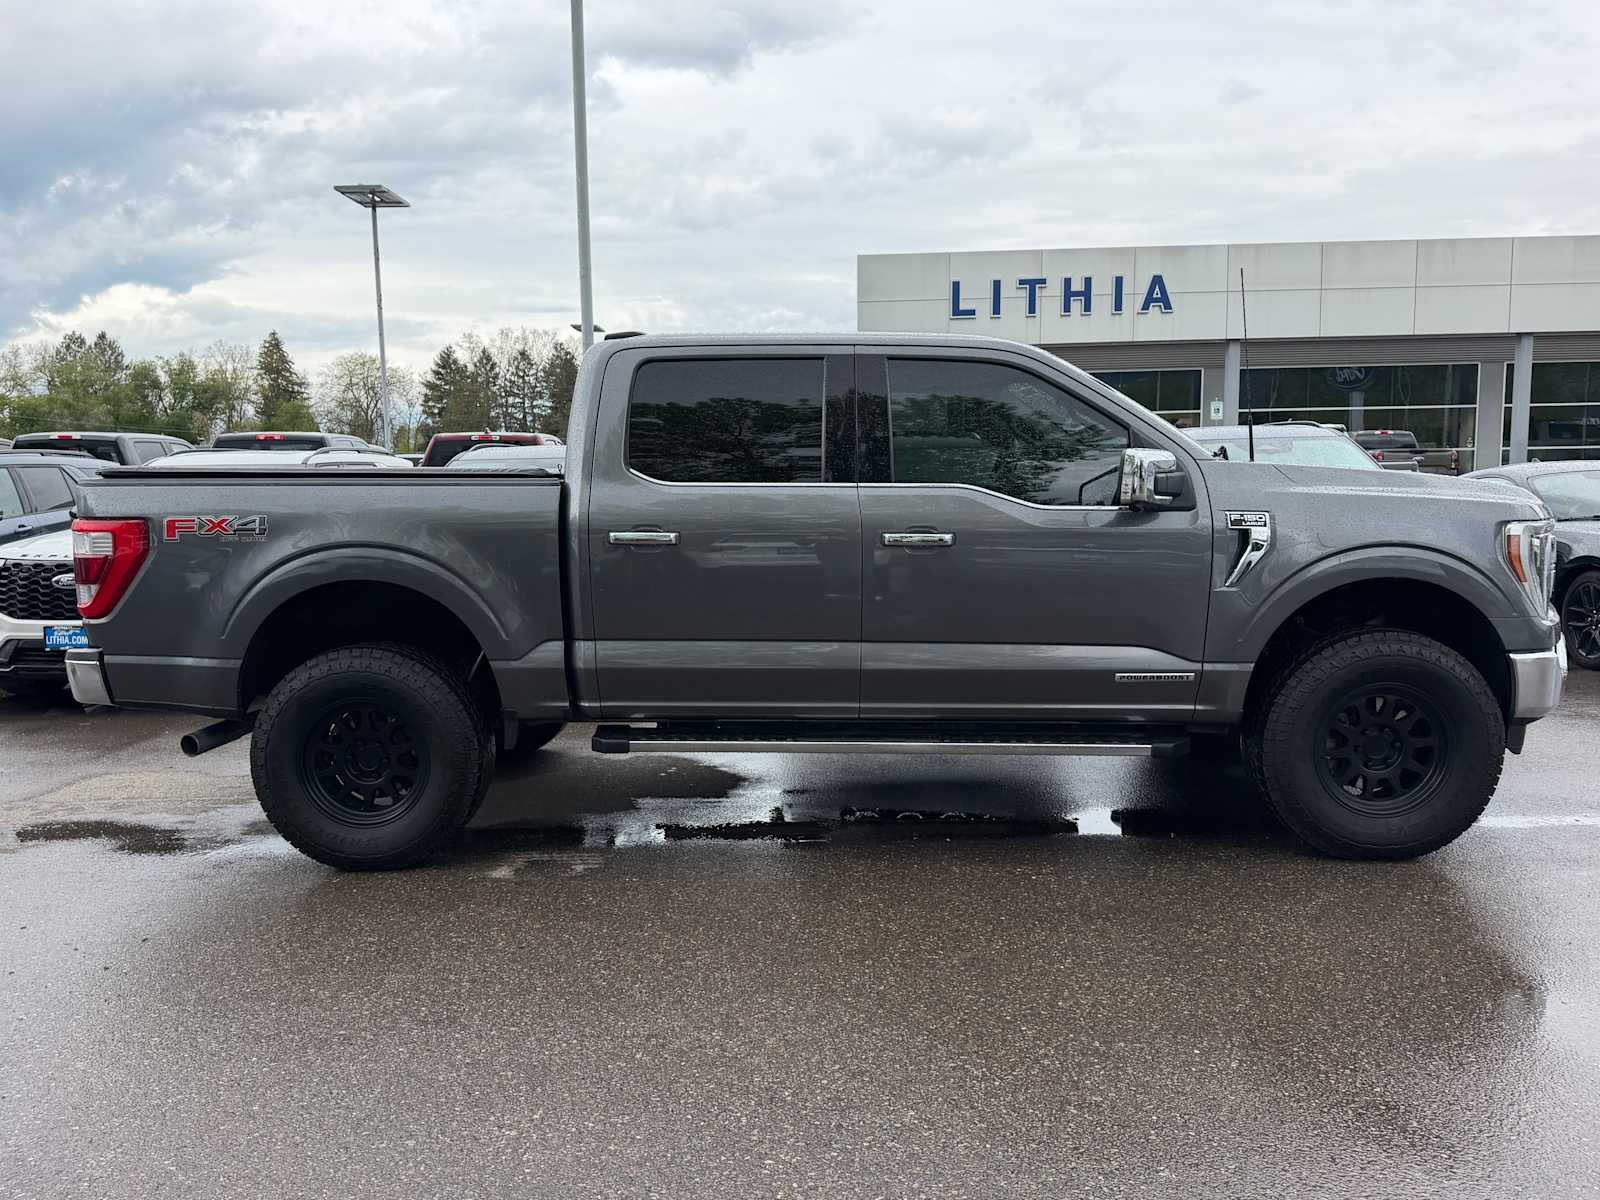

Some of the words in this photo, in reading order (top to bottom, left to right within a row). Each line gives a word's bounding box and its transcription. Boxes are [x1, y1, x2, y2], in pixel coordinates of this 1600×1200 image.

[950, 274, 1173, 319] LITHIA
[163, 515, 268, 542] FX4
[45, 635, 89, 645] LITHIA.COM
